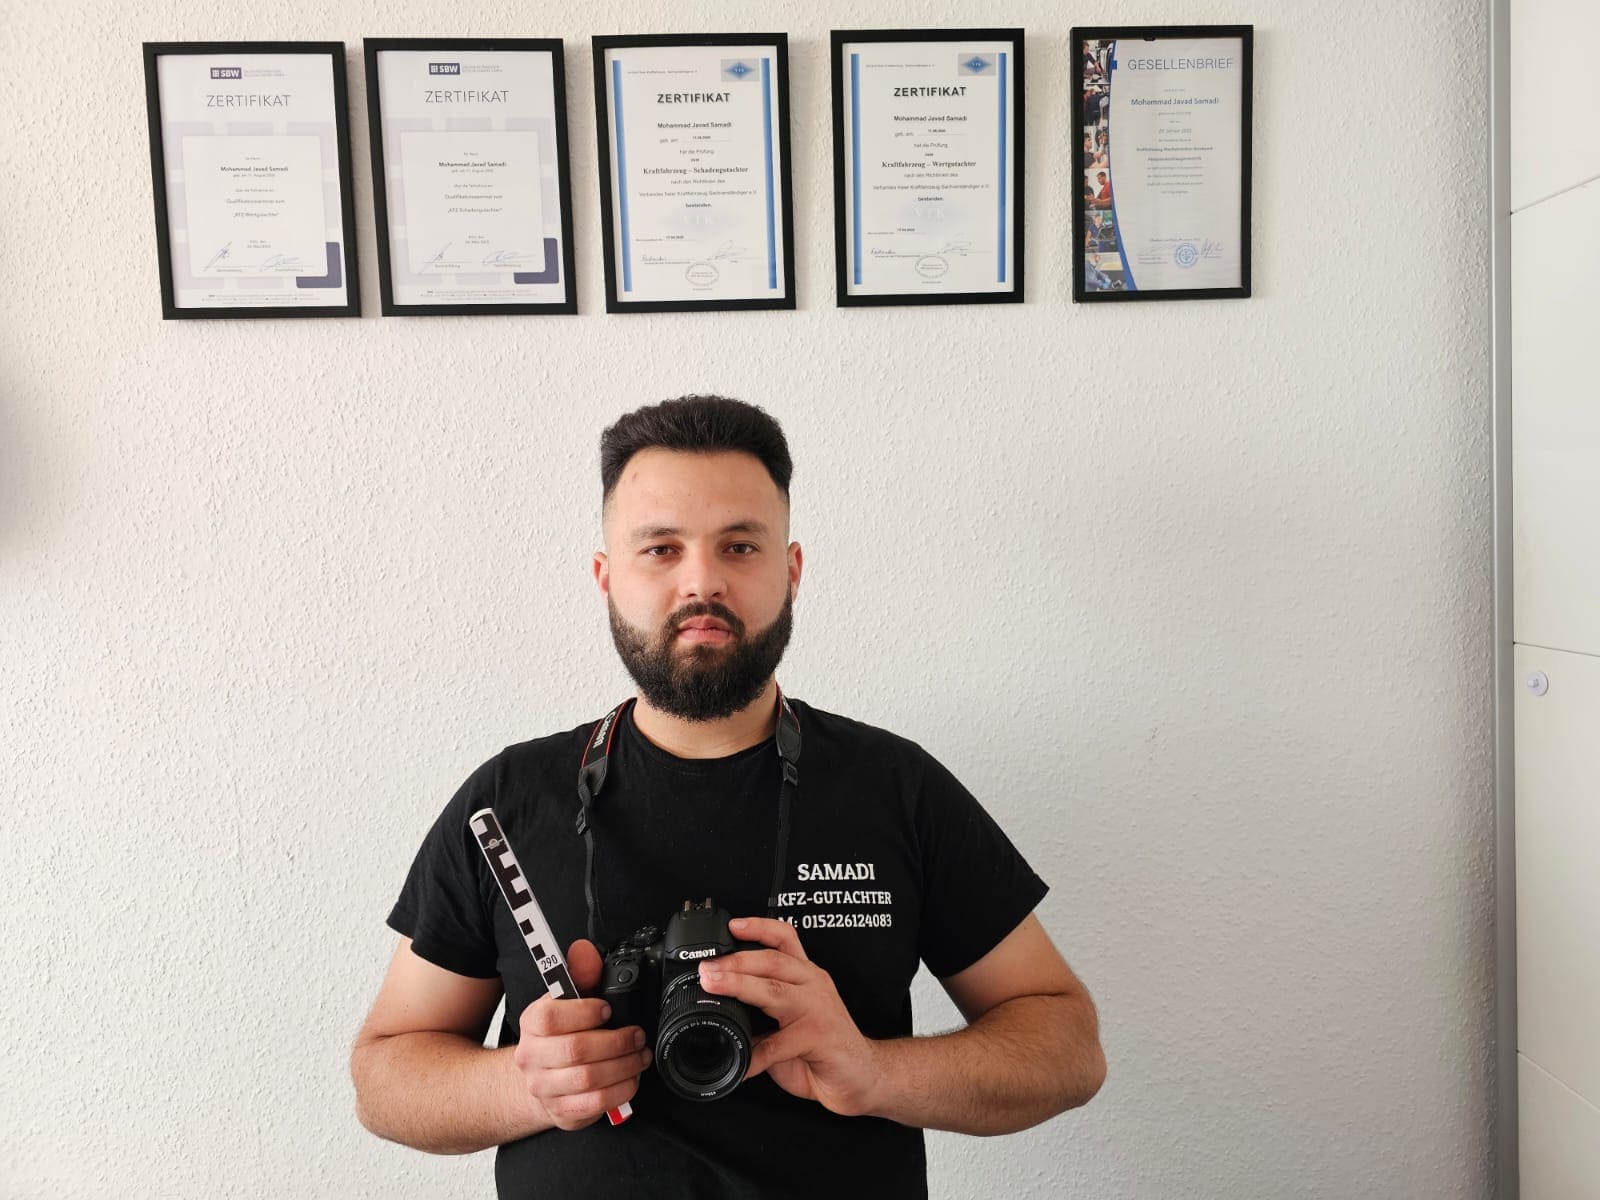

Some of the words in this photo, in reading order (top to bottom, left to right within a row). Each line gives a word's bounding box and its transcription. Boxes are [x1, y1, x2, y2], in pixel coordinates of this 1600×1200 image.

[439, 64, 458, 73] SBW
[1127, 58, 1234, 70] GESELLENBRIEF
[220, 69, 240, 78] SBW
[425, 90, 509, 103] ZERTIFIKAT
[894, 86, 967, 97] ZERTIFIKAT
[206, 94, 291, 107] ZERTIFIKAT
[657, 92, 730, 104] ZERTIFIKAT
[932, 160, 977, 168] Wertgutachter
[643, 167, 687, 175] Kraftfahrzeug
[693, 166, 749, 174] Schadengutachter
[797, 863, 876, 881] SAMADI
[777, 890, 892, 907] KFZ-GUTACHTER
[802, 913, 892, 929] 015226124083
[678, 948, 717, 960] Canon
[540, 954, 559, 971] 290
